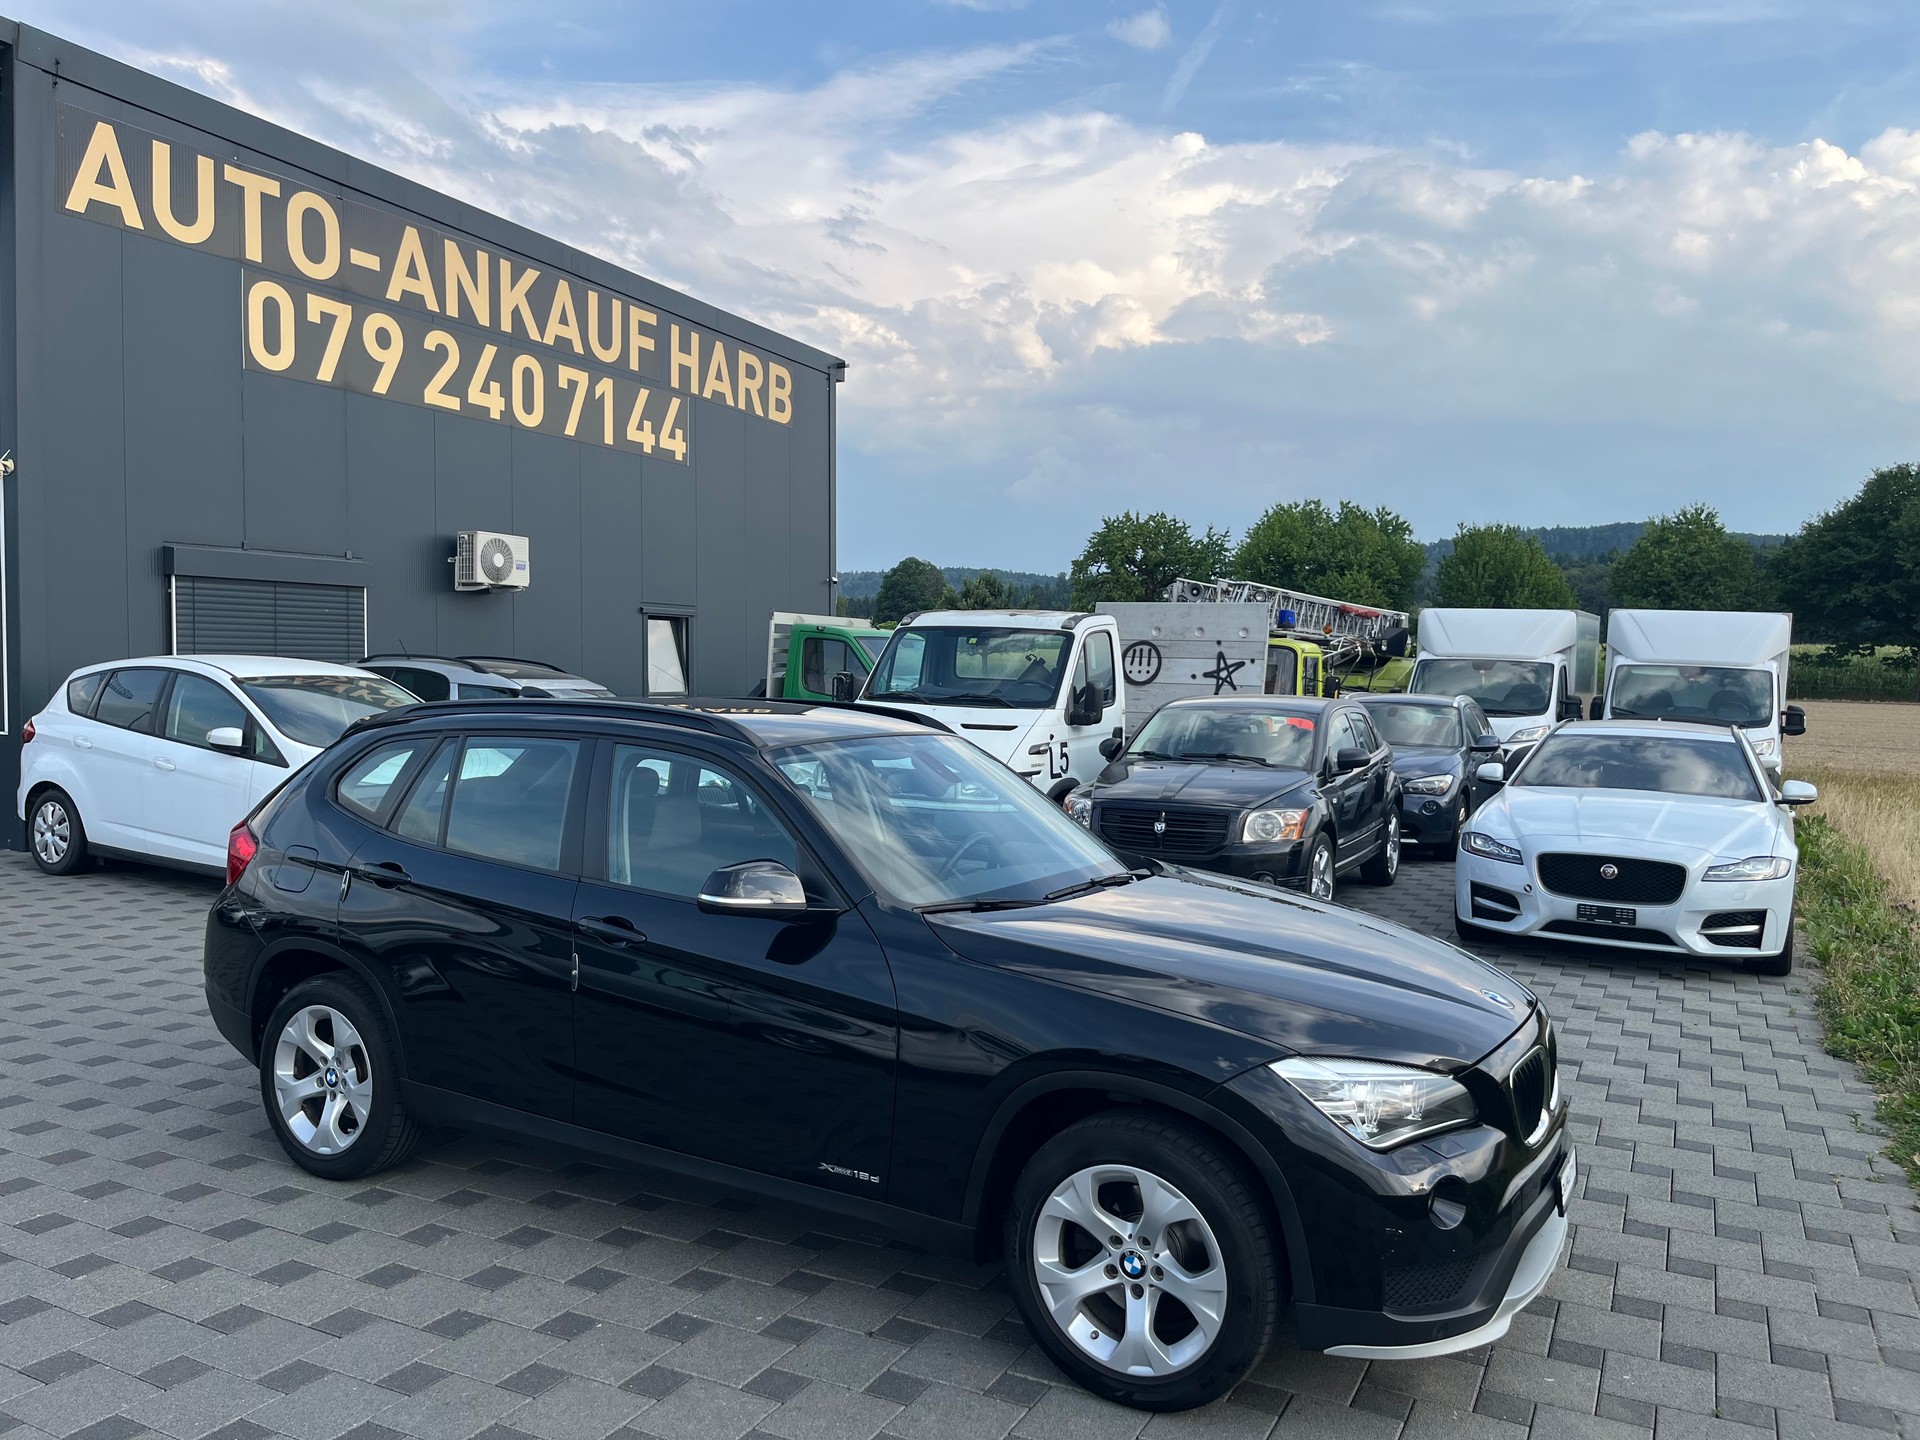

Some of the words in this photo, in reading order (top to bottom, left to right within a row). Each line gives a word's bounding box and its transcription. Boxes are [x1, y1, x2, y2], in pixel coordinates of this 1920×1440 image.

[64, 121, 658, 372] AUTO-ANKAUF
[670, 323, 793, 425] HARB
[247, 280, 404, 395] 079
